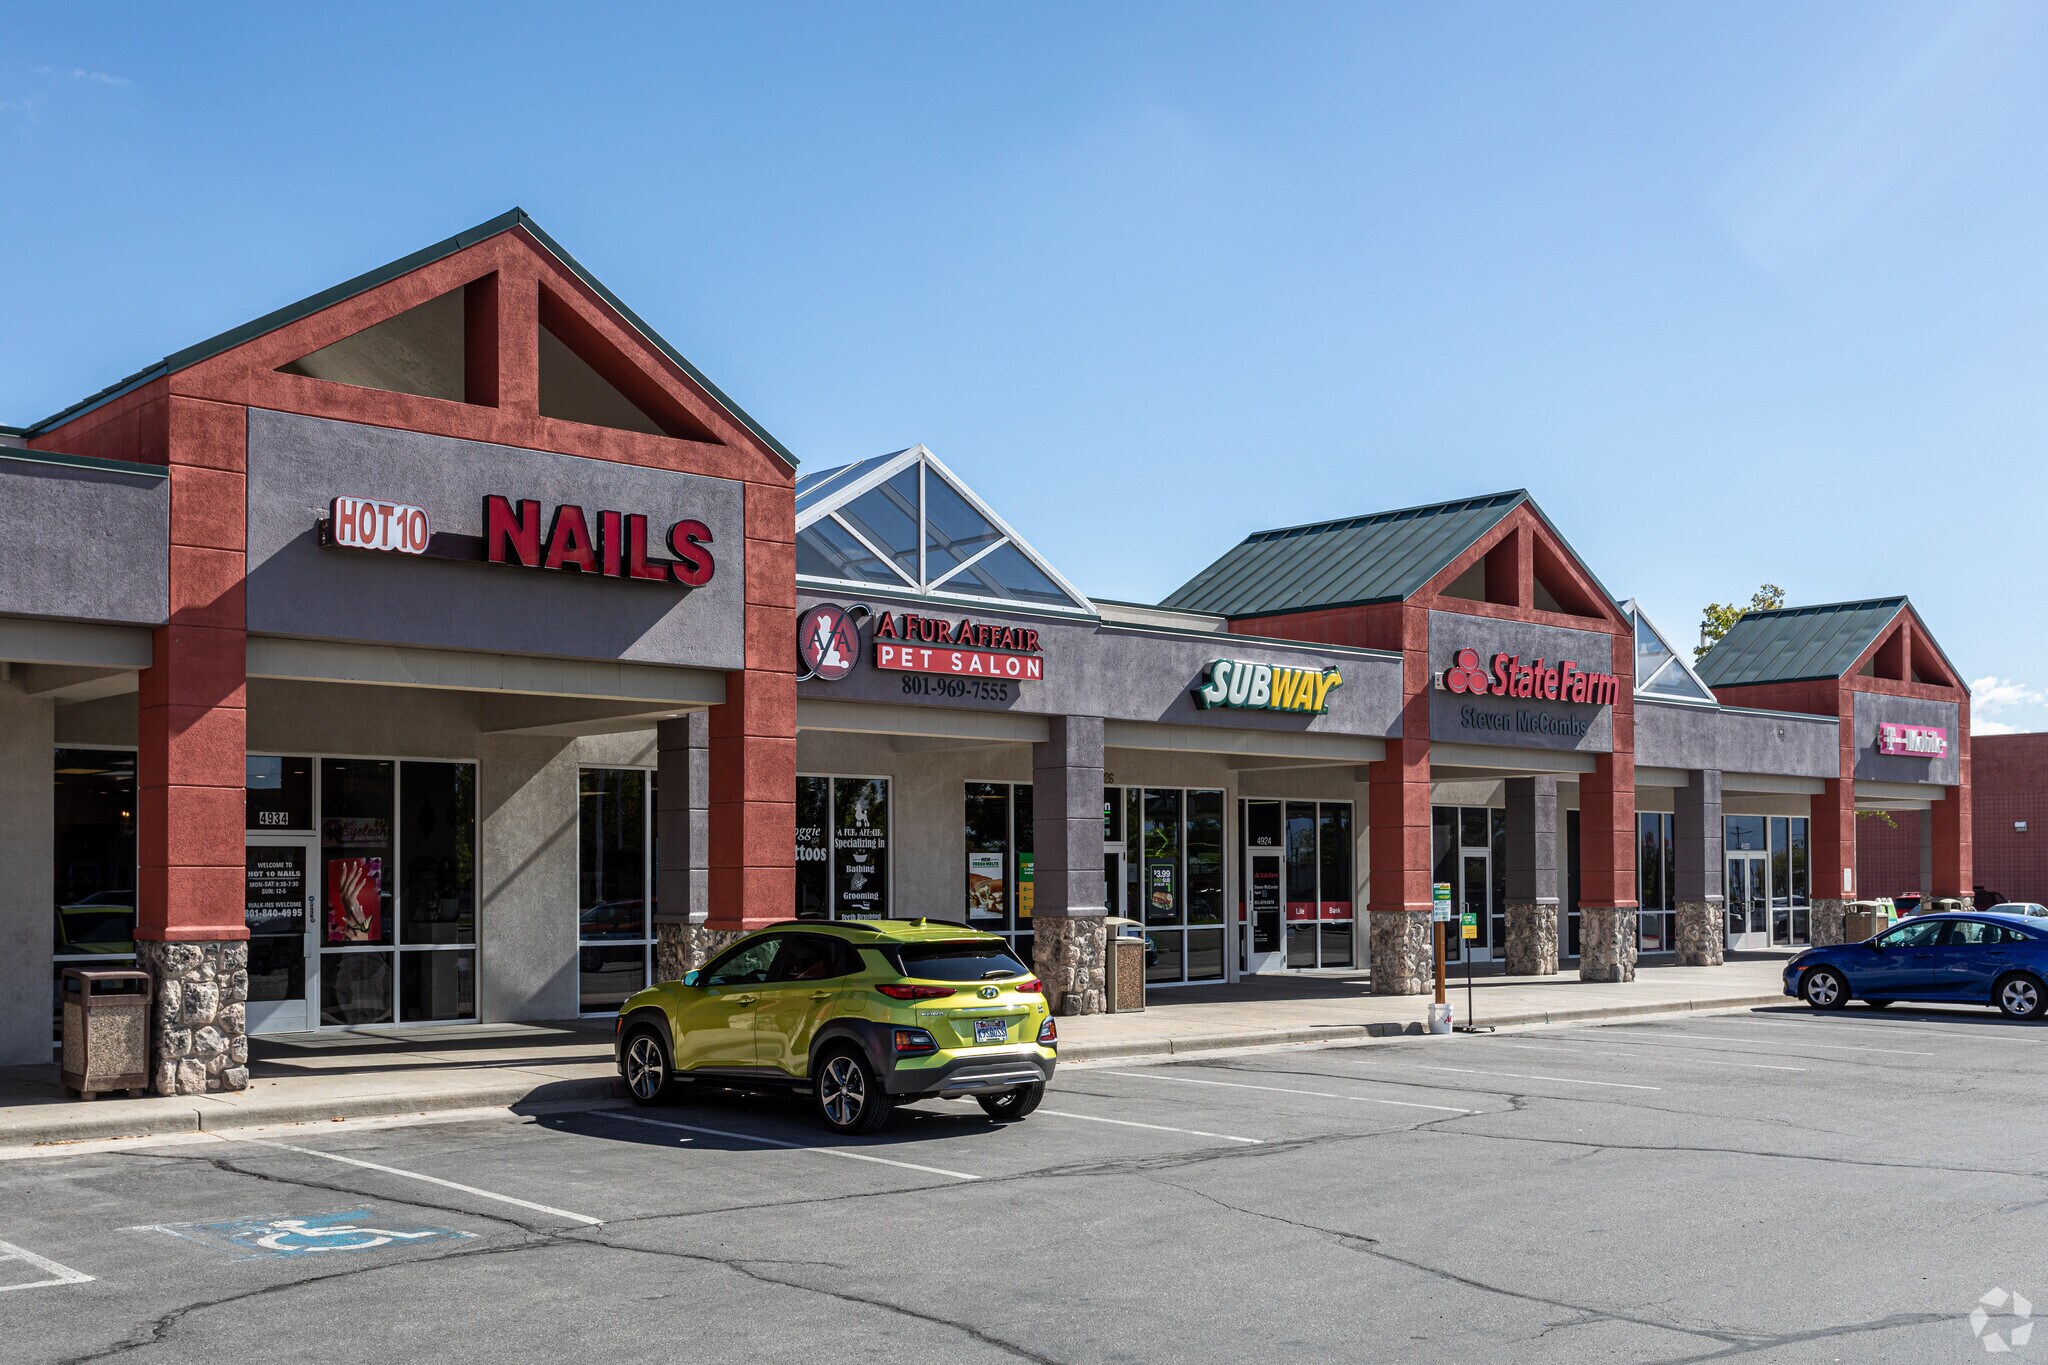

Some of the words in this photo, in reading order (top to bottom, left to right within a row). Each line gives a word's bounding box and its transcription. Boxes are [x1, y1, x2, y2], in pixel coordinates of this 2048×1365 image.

[486, 494, 715, 587] NAILS
[877, 611, 898, 639] A
[904, 613, 953, 644] FUR
[957, 618, 1043, 651] AFFAIR
[882, 646, 932, 669] PET
[951, 655, 1040, 677] SALON
[902, 675, 1008, 701] 801-969-7555
[1193, 658, 1343, 714] SUBWAY
[1461, 705, 1513, 733] Steven
[1517, 711, 1588, 738] McCombs
[260, 812, 288, 825] 4934
[834, 838, 877, 849] Specializing
[878, 838, 886, 848] in
[1257, 837, 1272, 845] 4924
[846, 865, 875, 874] Bathing
[1153, 869, 1171, 878] $3.99
[843, 892, 879, 901] Grooming
